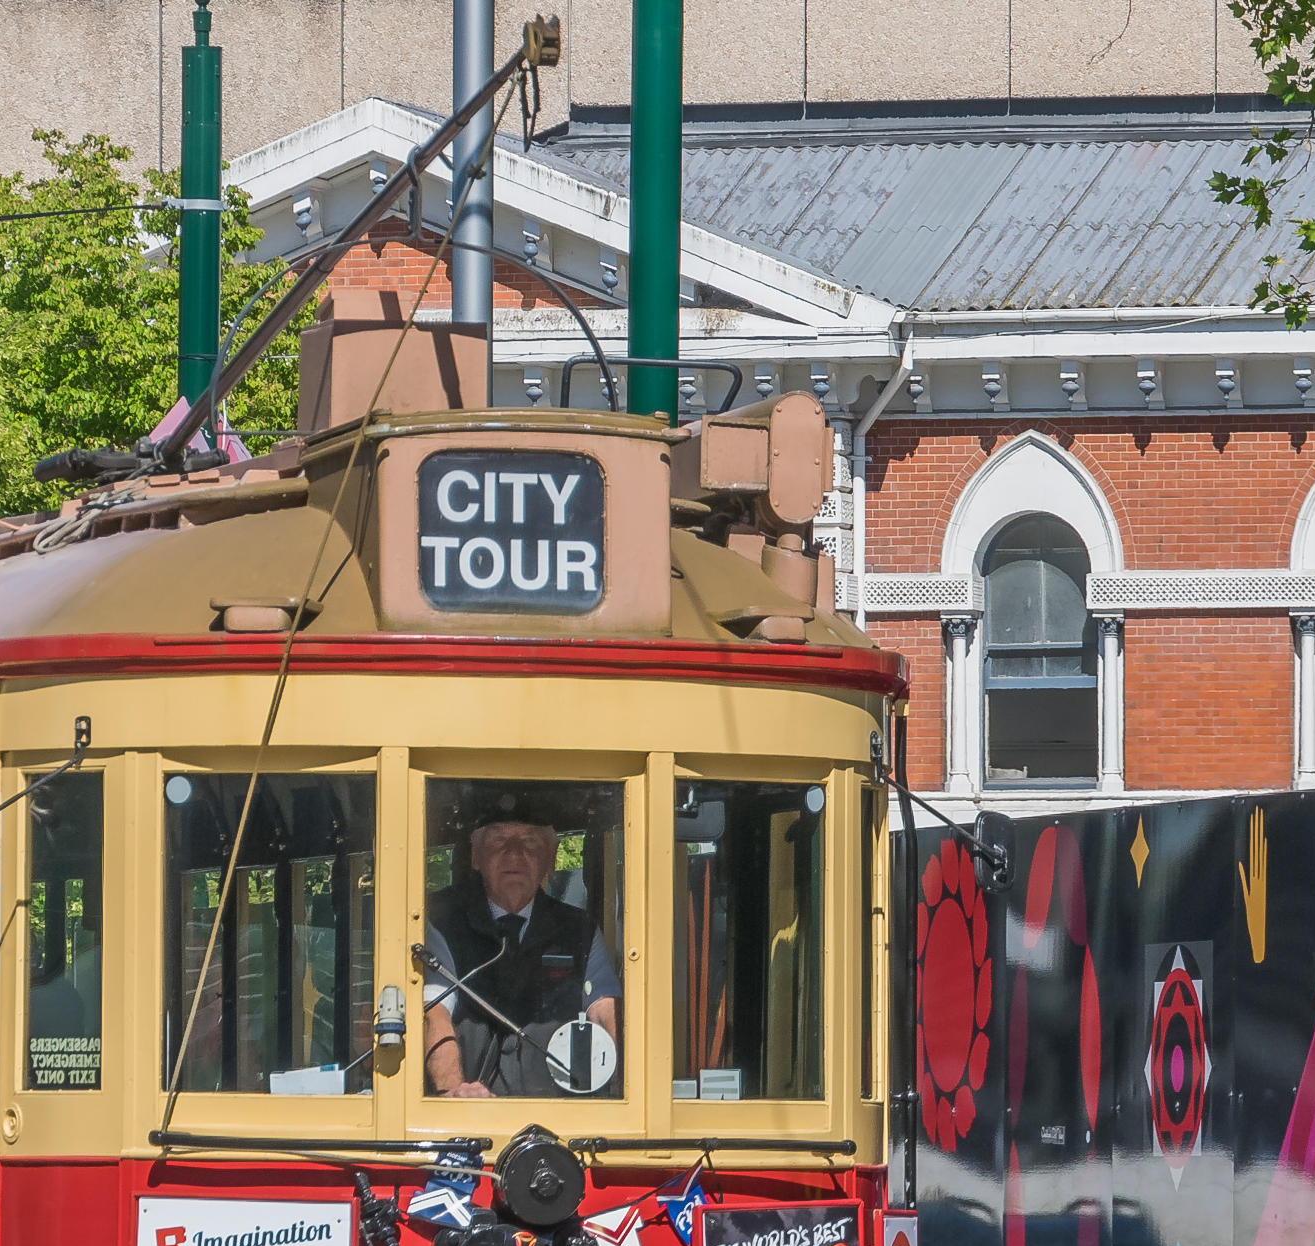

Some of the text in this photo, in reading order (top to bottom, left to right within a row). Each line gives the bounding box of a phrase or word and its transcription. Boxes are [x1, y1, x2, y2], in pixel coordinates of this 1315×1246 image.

[437, 470, 581, 525] CITY
[421, 536, 597, 591] TOUR
[600, 1051, 606, 1066] 1
